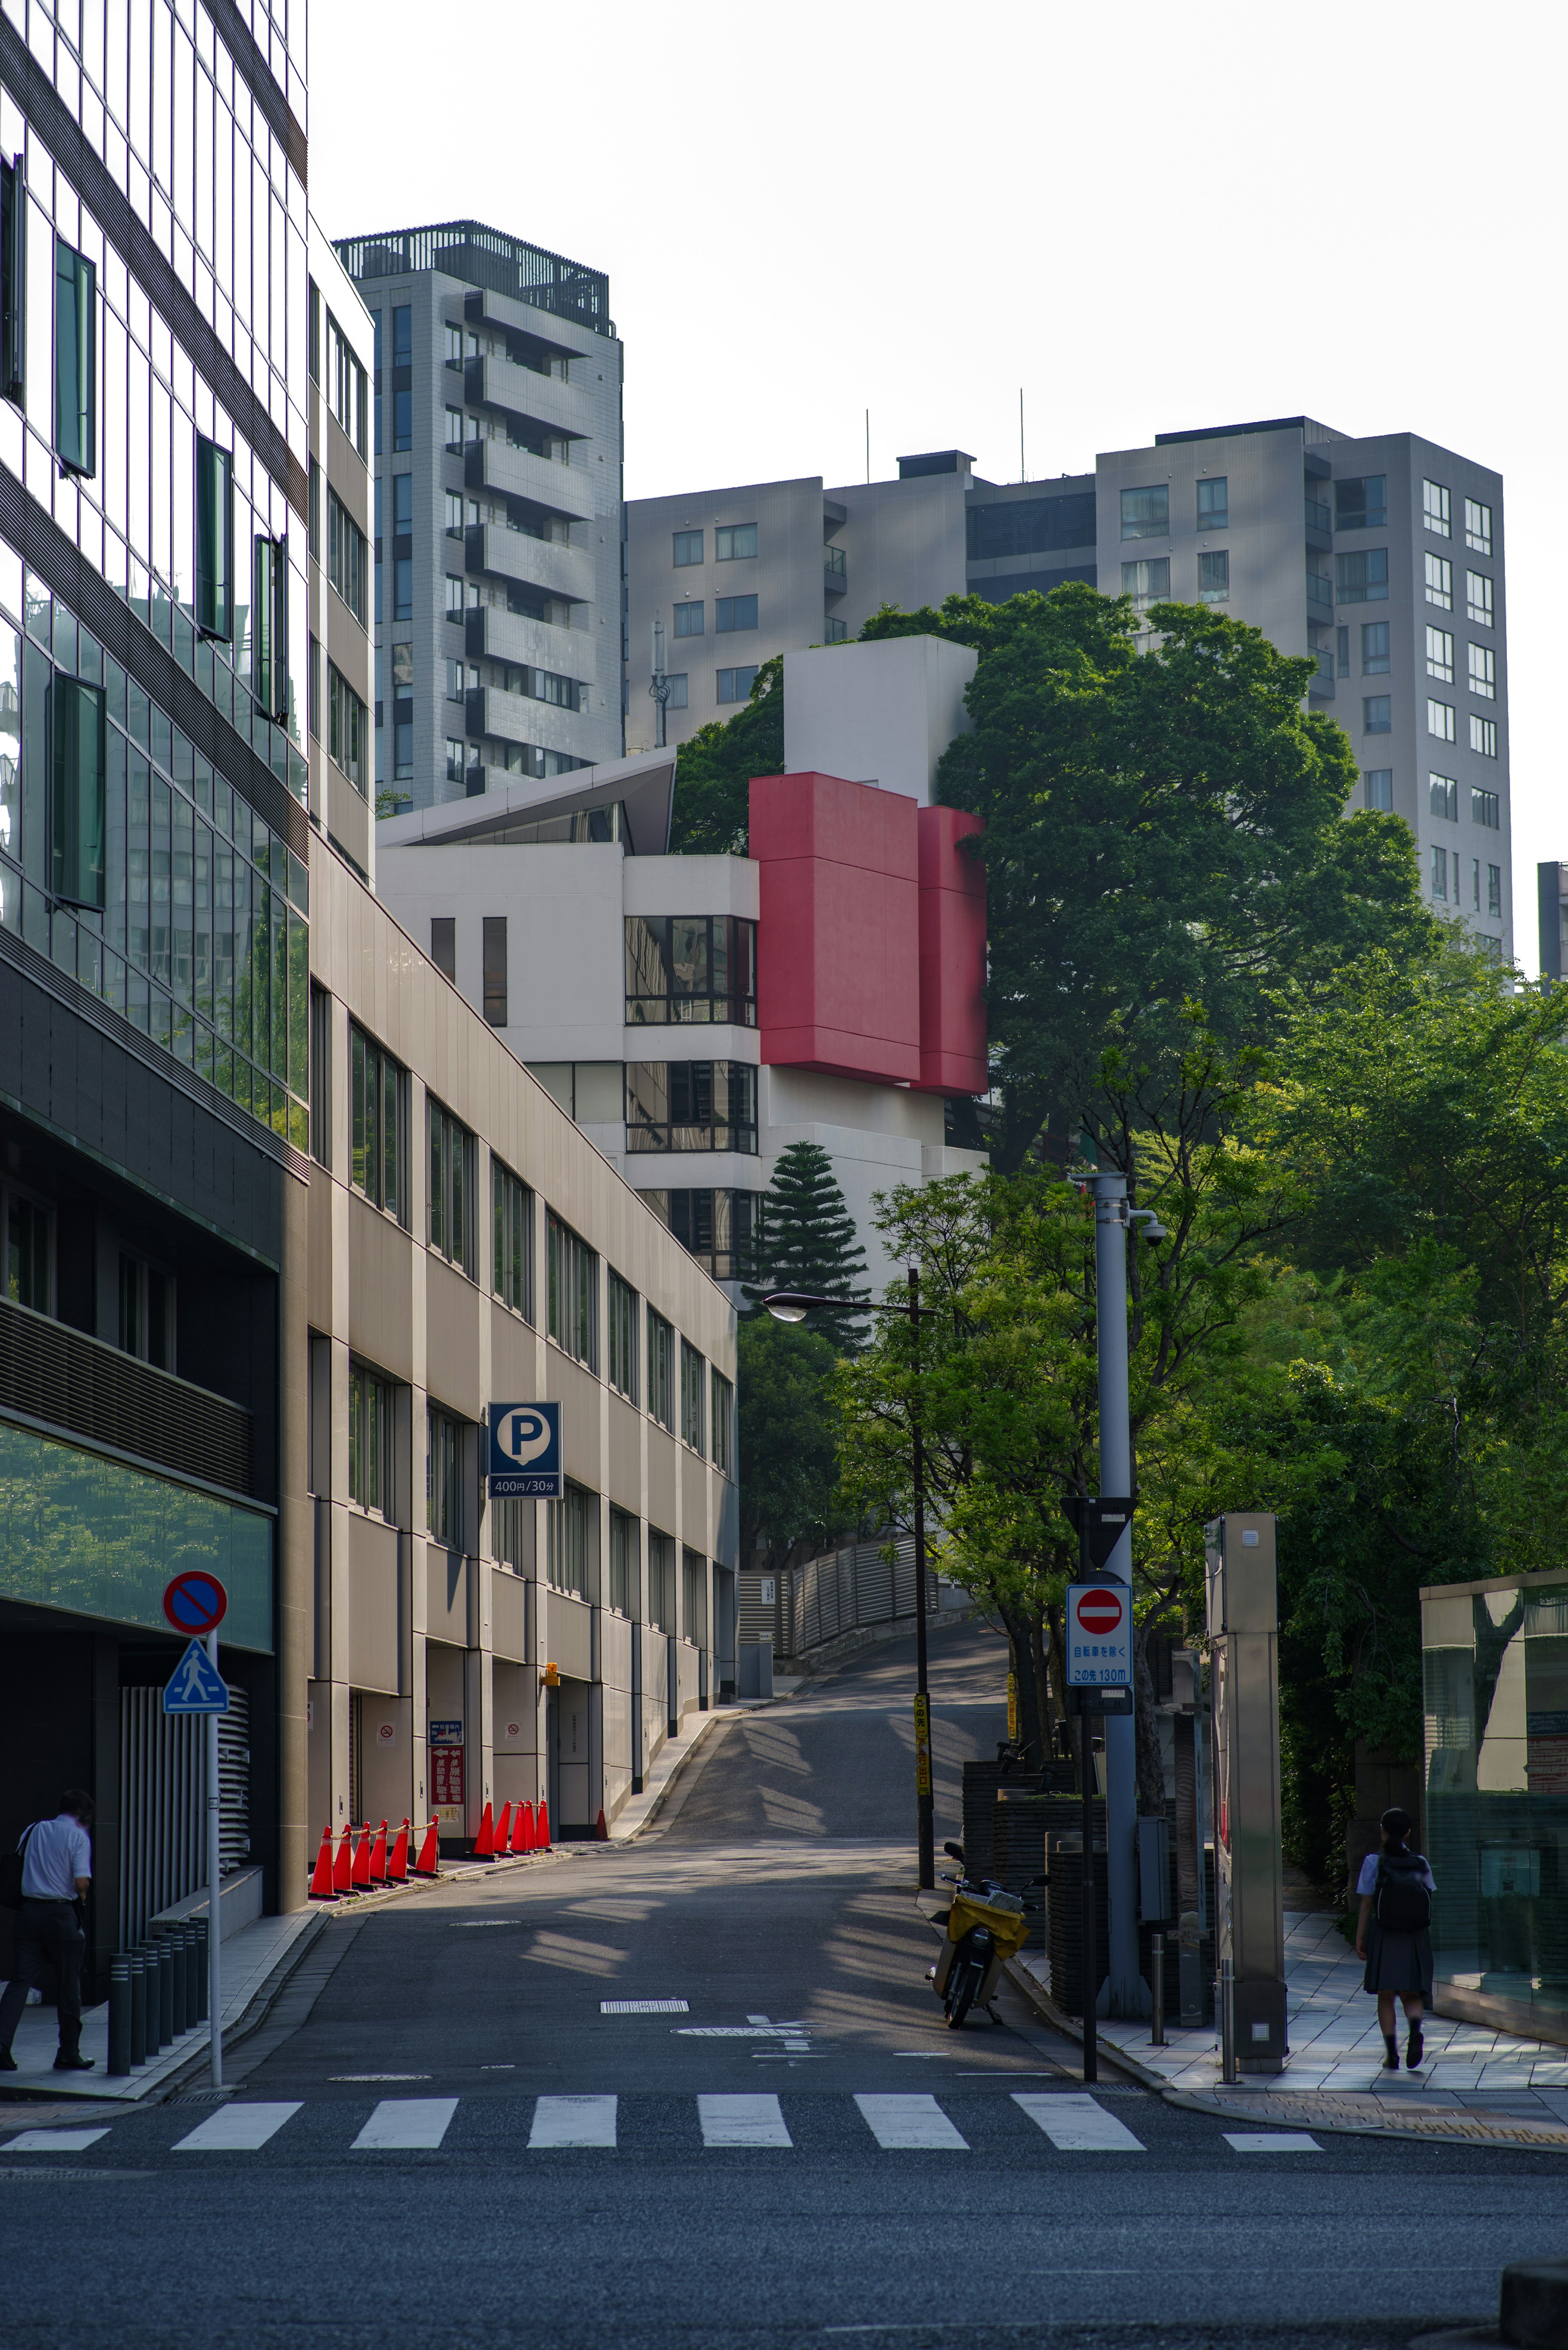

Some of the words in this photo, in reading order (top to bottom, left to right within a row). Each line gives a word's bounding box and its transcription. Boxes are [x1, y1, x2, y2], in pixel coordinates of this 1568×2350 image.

[512, 1415, 543, 1455] P
[1074, 1646, 1125, 1657] 自転車を除く
